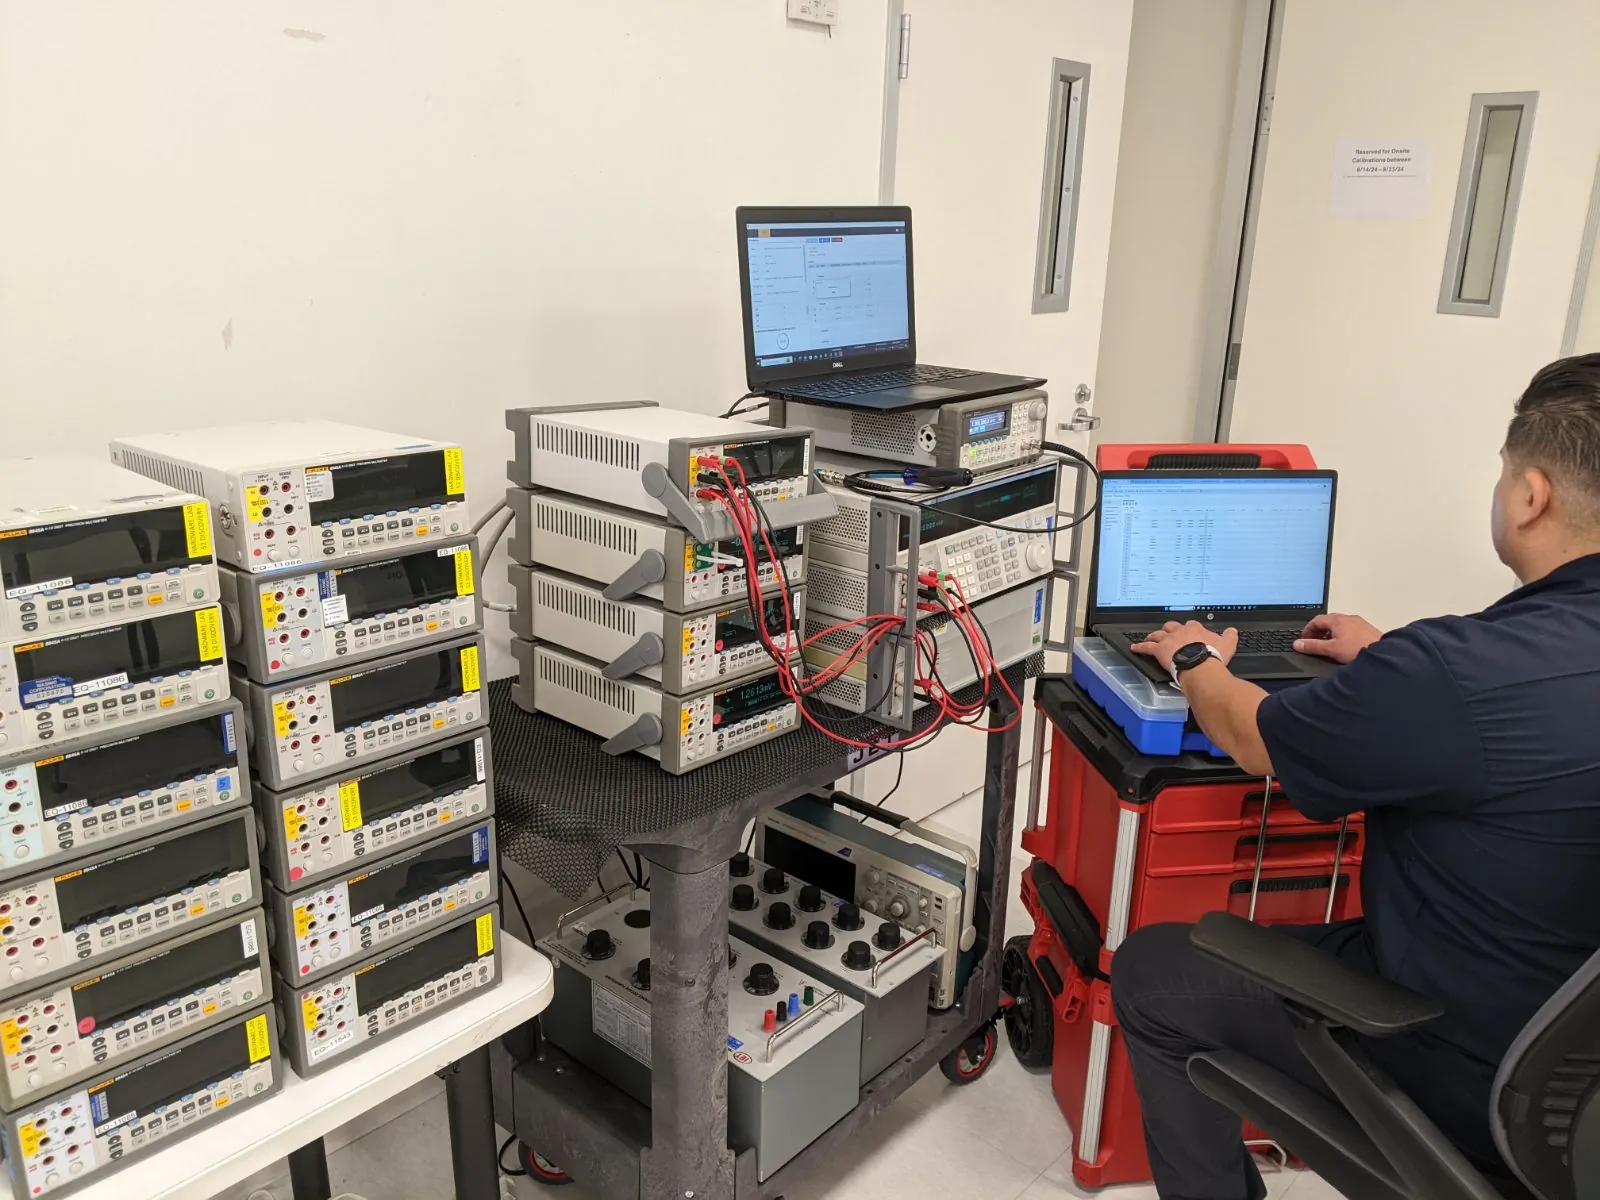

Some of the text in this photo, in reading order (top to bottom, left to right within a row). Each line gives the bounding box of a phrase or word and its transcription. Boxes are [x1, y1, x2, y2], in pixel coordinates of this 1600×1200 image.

[187, 519, 197, 553] HARDWARE
[195, 507, 205, 541] DISCOVERY
[9, 579, 72, 596] EQ-11086
[200, 624, 209, 657] HARDWARE
[208, 612, 217, 644] DISCOVERY
[74, 675, 126, 692] EQ-11086
[46, 800, 88, 816] EQ-11086
[245, 924, 254, 953] EQ-11086
[97, 1112, 136, 1133] EQ-11086
